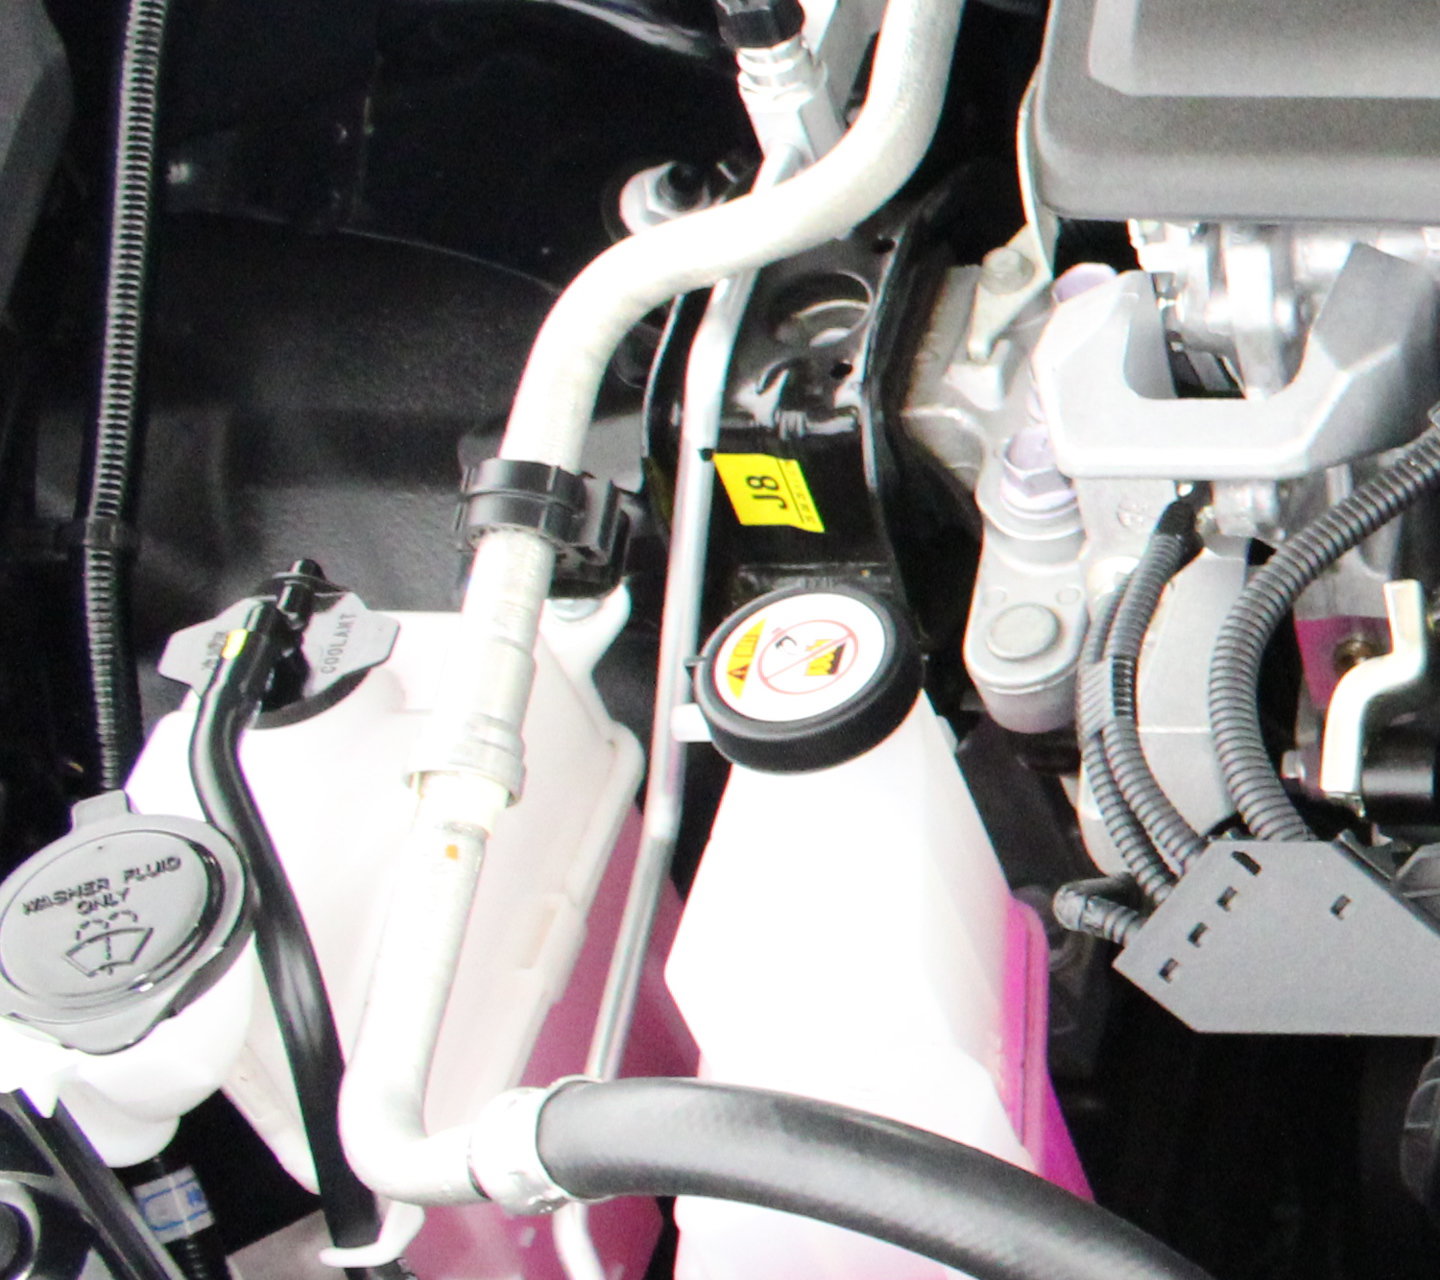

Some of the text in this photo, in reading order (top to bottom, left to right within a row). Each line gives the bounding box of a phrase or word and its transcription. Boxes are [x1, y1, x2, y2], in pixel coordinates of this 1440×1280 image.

[746, 476, 787, 509] J8
[322, 613, 356, 674] COOLANT
[22, 856, 182, 915] WASHER FLUID
[77, 887, 130, 916] ONLY
